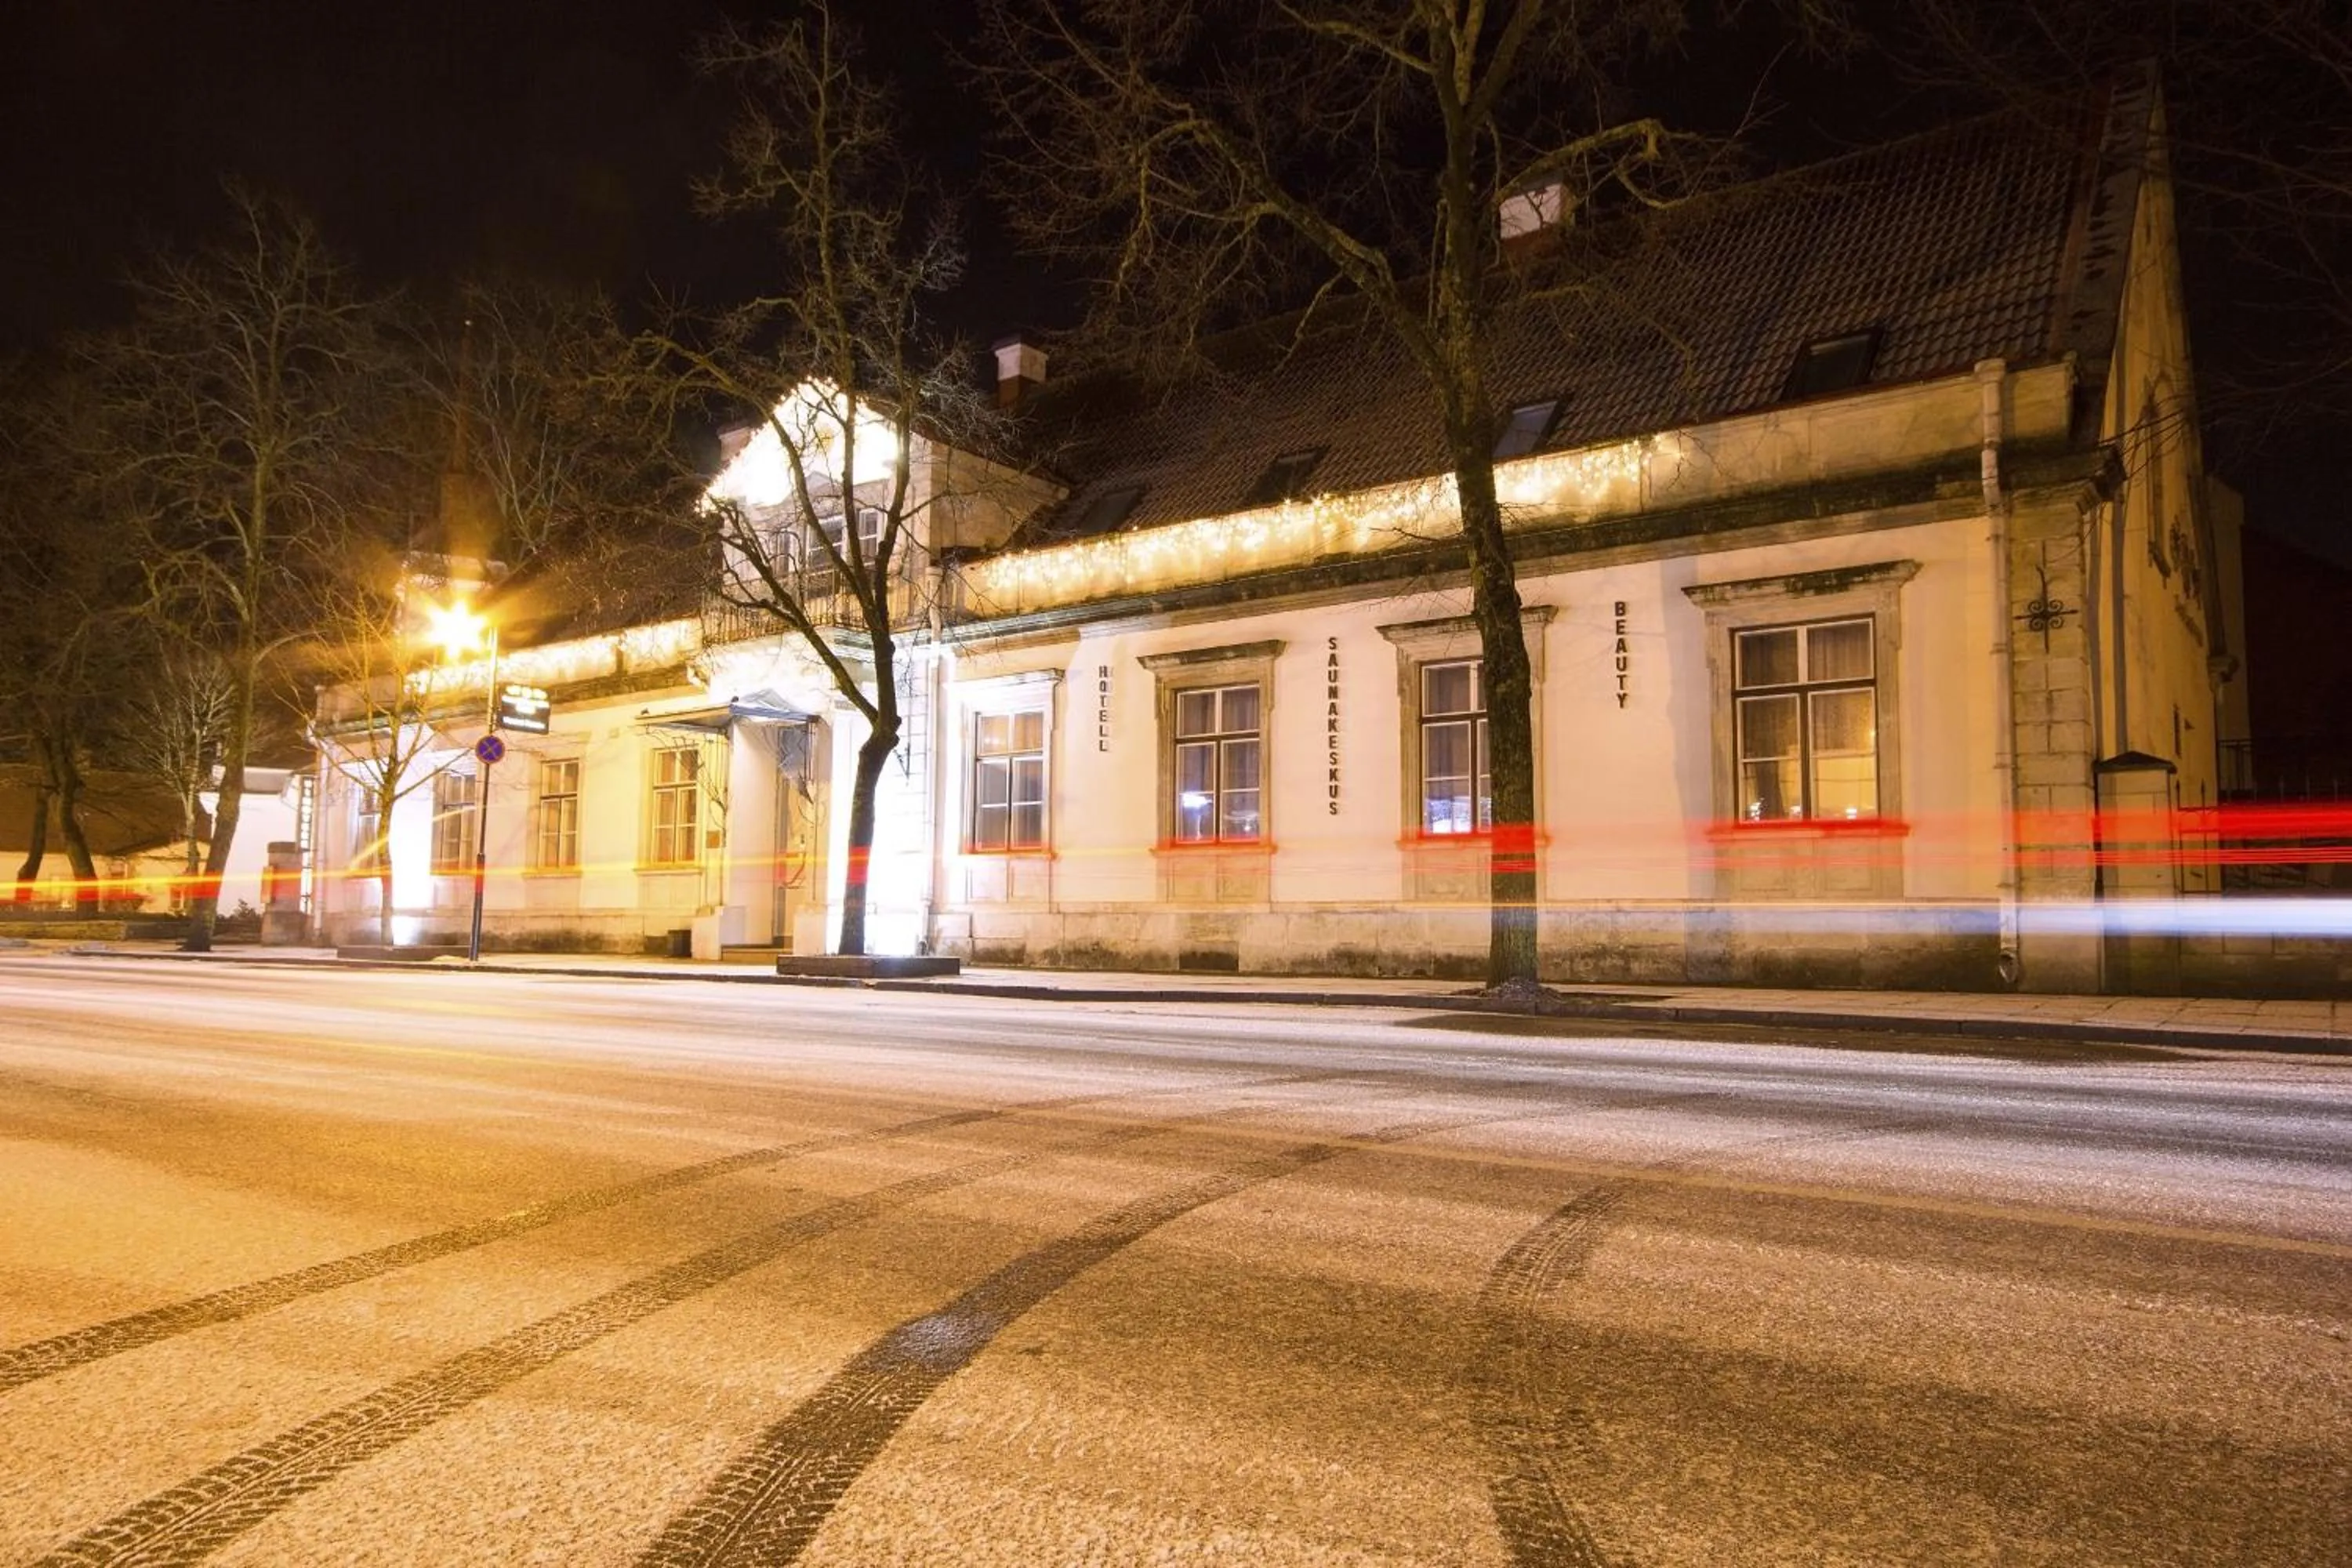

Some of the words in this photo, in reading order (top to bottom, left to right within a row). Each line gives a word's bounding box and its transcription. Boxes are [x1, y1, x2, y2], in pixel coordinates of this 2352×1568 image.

[1098, 665, 1109, 752] HOTELL
[1614, 601, 1628, 710] BEAUTY
[1328, 637, 1339, 816] SAUNAKESKUS
